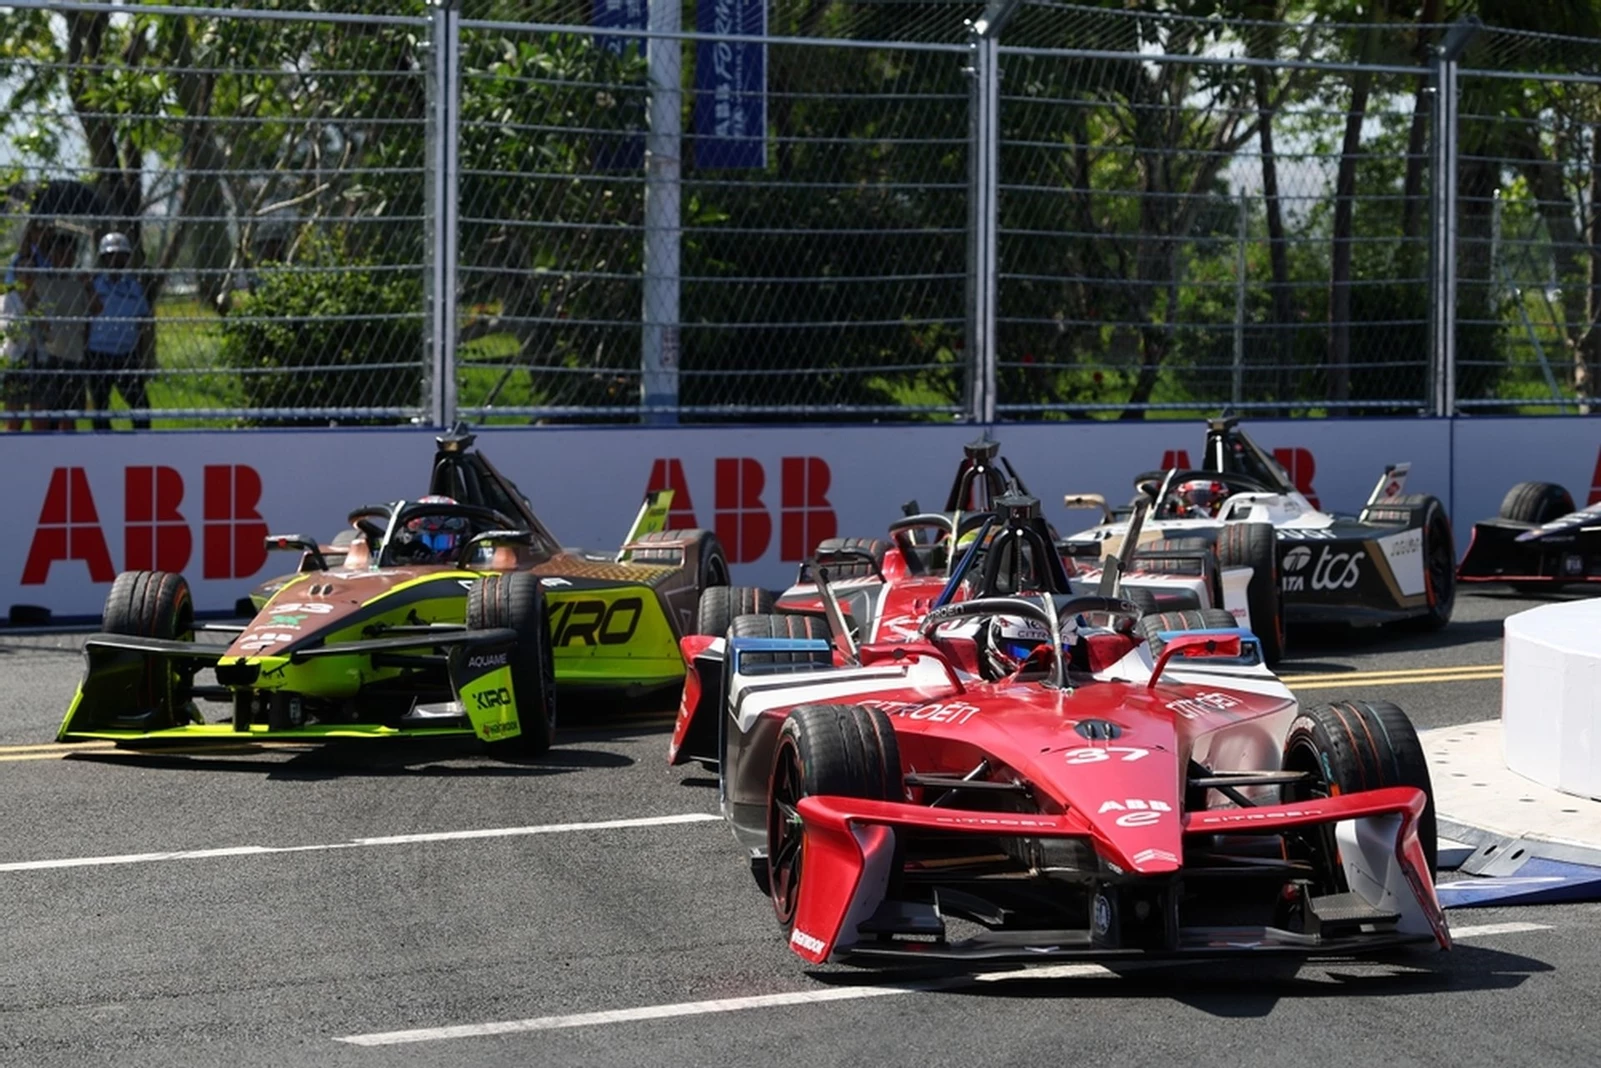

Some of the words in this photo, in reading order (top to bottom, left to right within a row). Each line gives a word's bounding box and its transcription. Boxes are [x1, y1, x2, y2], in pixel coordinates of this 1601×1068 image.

[20, 464, 270, 585] ABB
[1311, 545, 1366, 590] tcs
[239, 633, 293, 643] ABB
[471, 687, 512, 711] KIRO
[1065, 747, 1150, 765] 37
[1097, 799, 1172, 813] ABB
